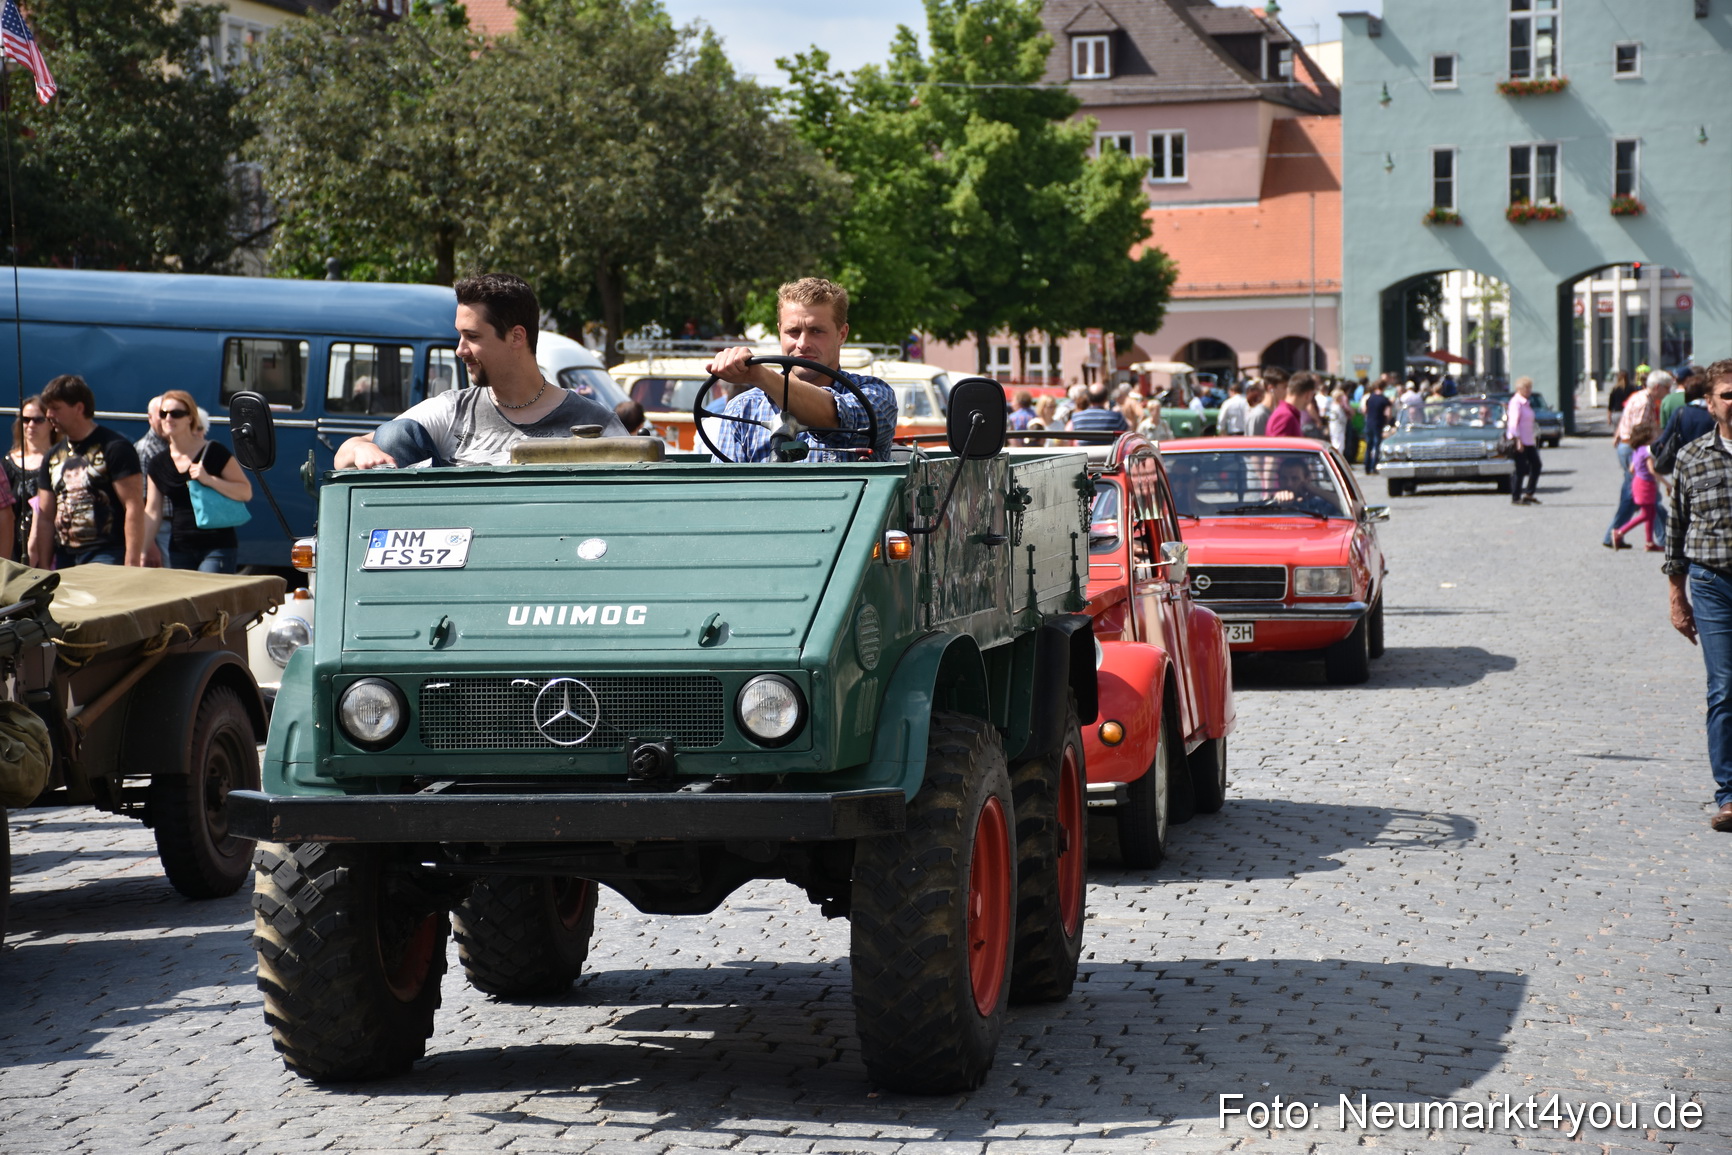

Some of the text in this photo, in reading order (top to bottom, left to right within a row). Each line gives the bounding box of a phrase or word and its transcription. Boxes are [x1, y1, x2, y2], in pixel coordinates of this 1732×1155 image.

[391, 531, 426, 547] NM
[380, 549, 451, 565] FS 57
[507, 605, 647, 625] UNIMOG
